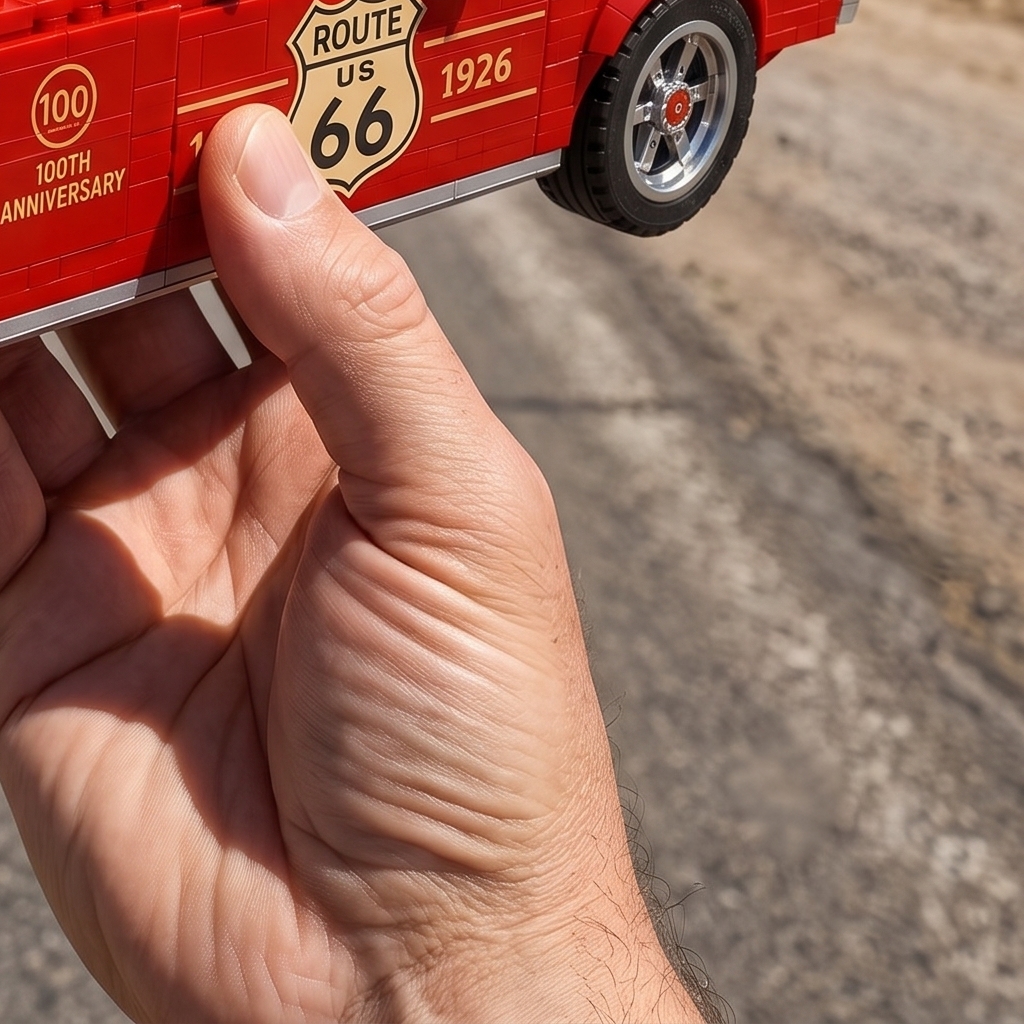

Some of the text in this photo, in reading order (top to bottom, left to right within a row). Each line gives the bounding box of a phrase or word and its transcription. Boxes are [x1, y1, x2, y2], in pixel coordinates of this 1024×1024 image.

[312, 4, 403, 57] ROUTE
[337, 59, 375, 88] US
[440, 47, 513, 99] 1926
[39, 84, 89, 126] 100
[310, 85, 394, 170] 66
[35, 149, 91, 186] 100TH
[0, 167, 126, 225] ANNIVERSARY
